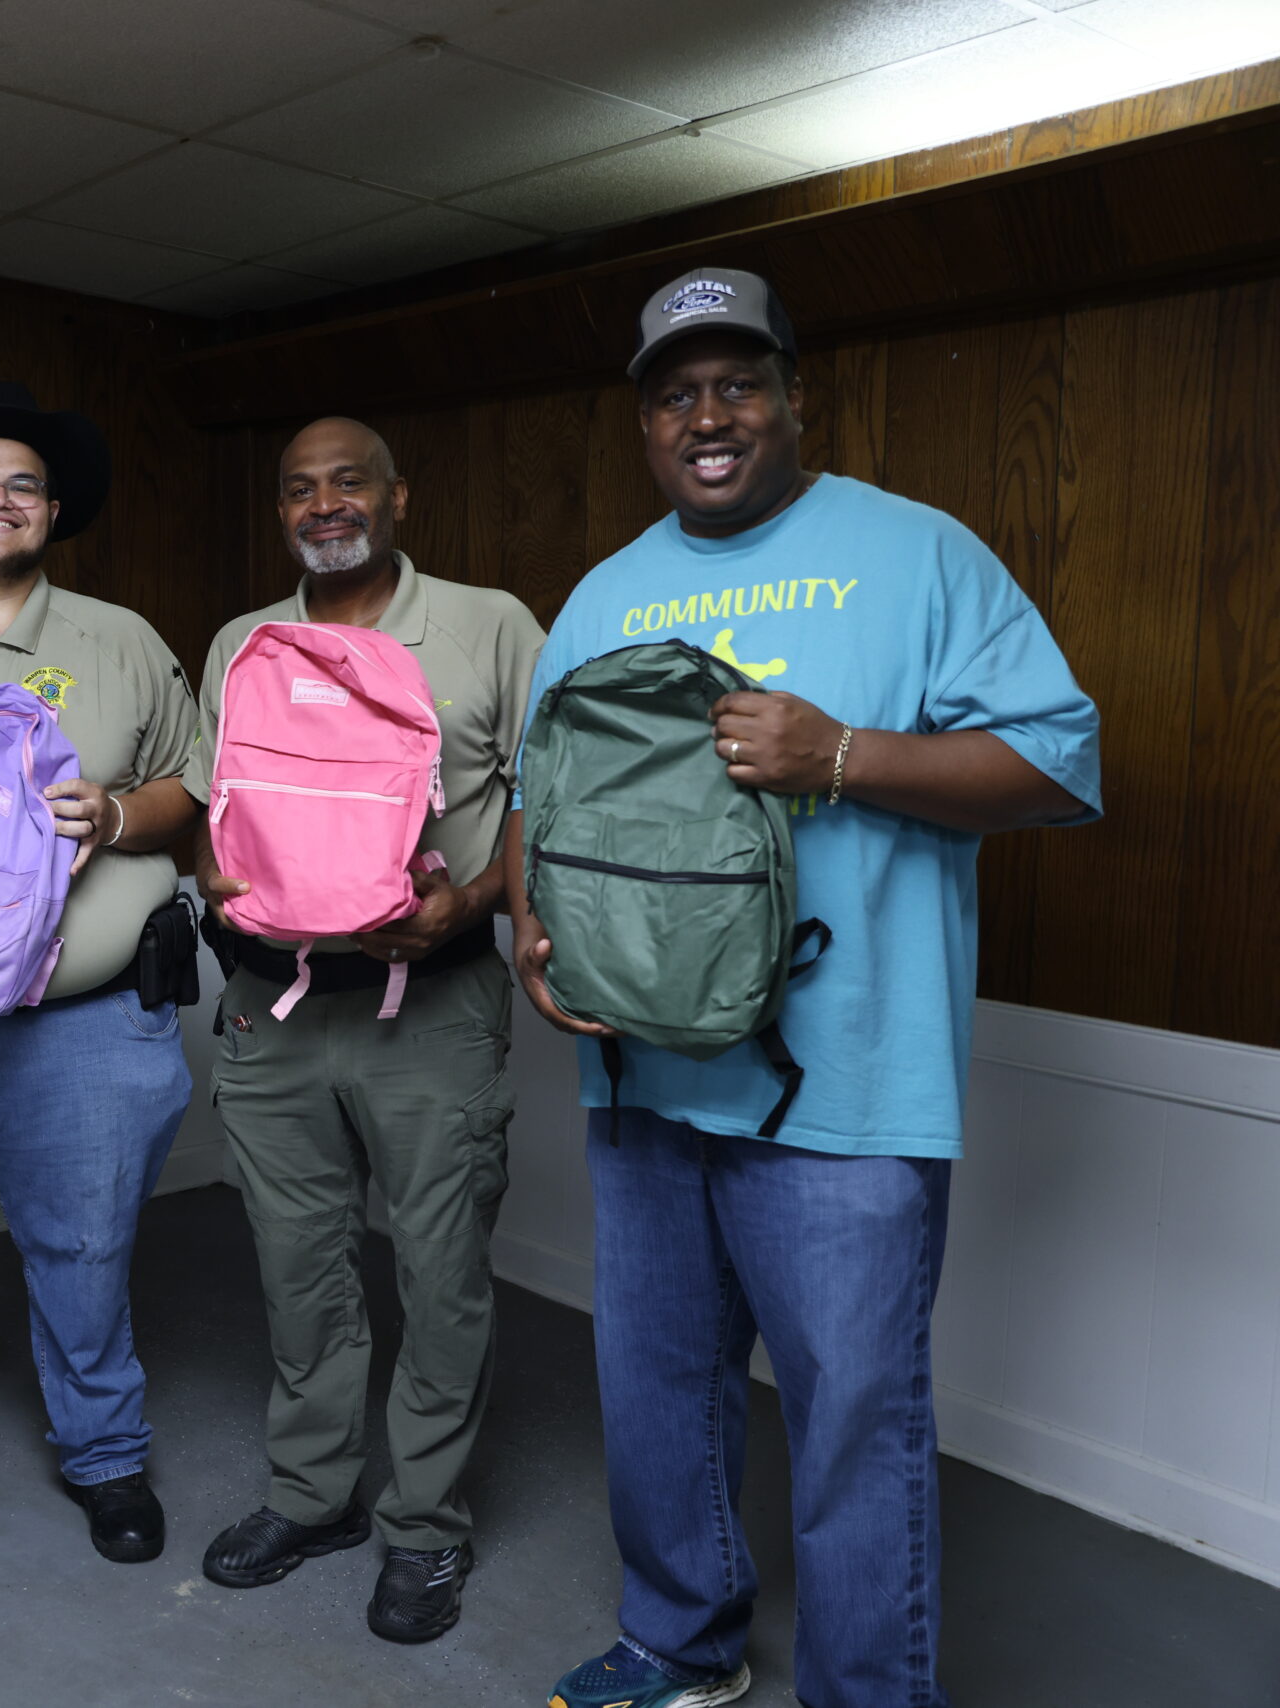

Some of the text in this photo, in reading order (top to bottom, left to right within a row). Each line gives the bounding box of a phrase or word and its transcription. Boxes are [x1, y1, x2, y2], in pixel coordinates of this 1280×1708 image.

[662, 280, 737, 313] CAPITAL
[681, 295, 714, 310] Ford
[622, 578, 859, 637] COMMUNITY
[23, 668, 72, 684] WARREN COUNTY
